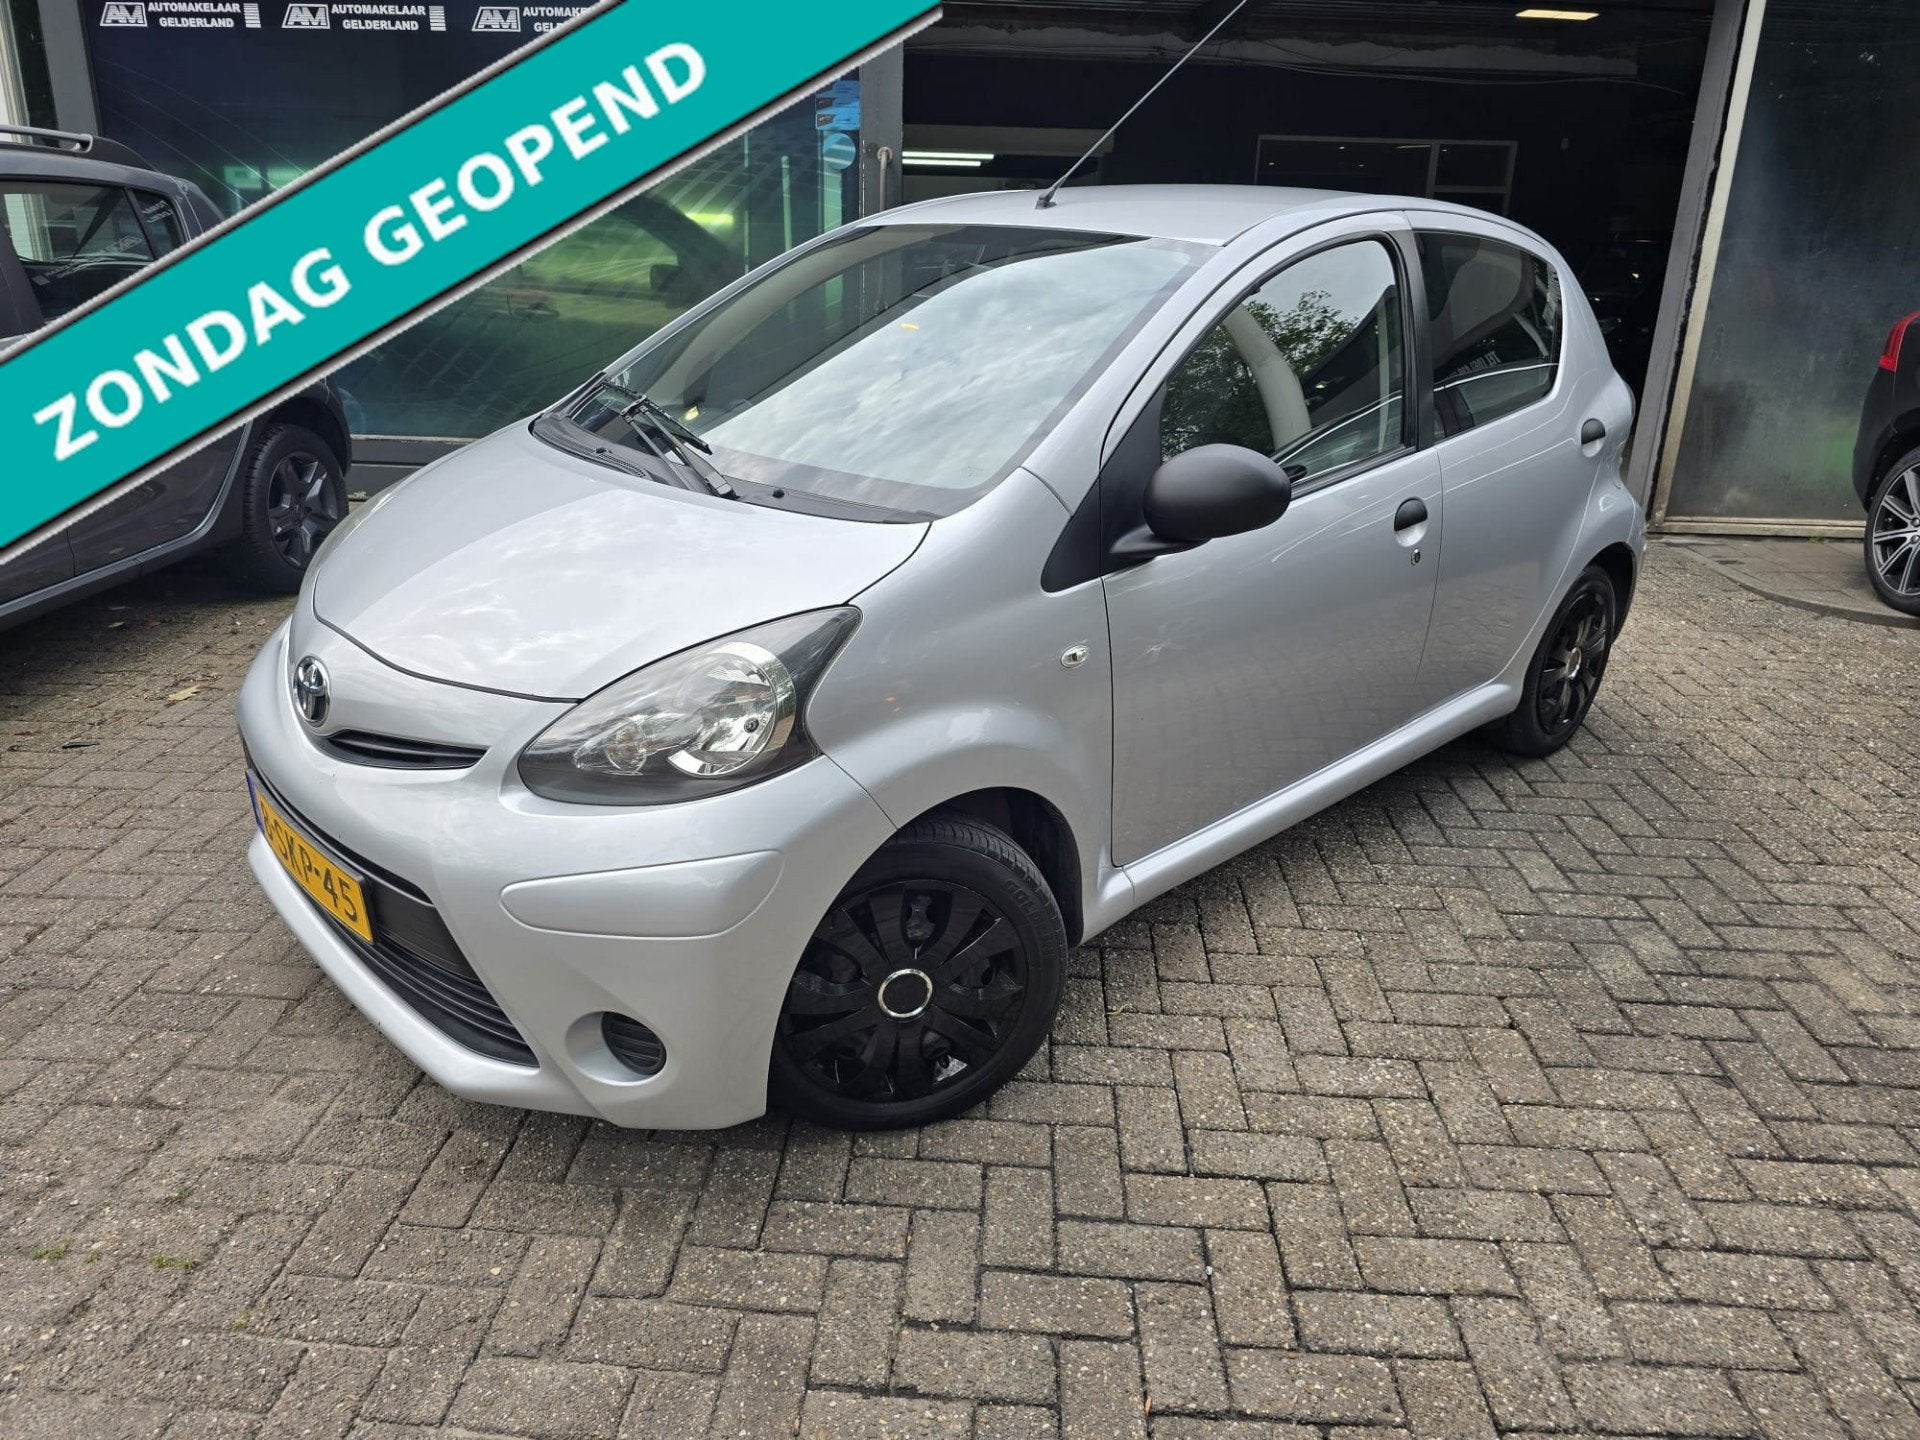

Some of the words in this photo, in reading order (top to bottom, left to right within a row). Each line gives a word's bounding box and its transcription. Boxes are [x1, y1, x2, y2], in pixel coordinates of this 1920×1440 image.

[148, 2, 241, 13] AUTOMAKELAAR
[331, 4, 426, 15] AUTOMAKELAAR
[105, 4, 144, 24] AM
[287, 6, 327, 26] AM
[477, 9, 518, 29] AM
[159, 17, 235, 28] GELDERLAND
[342, 19, 419, 31] GELDERLAND
